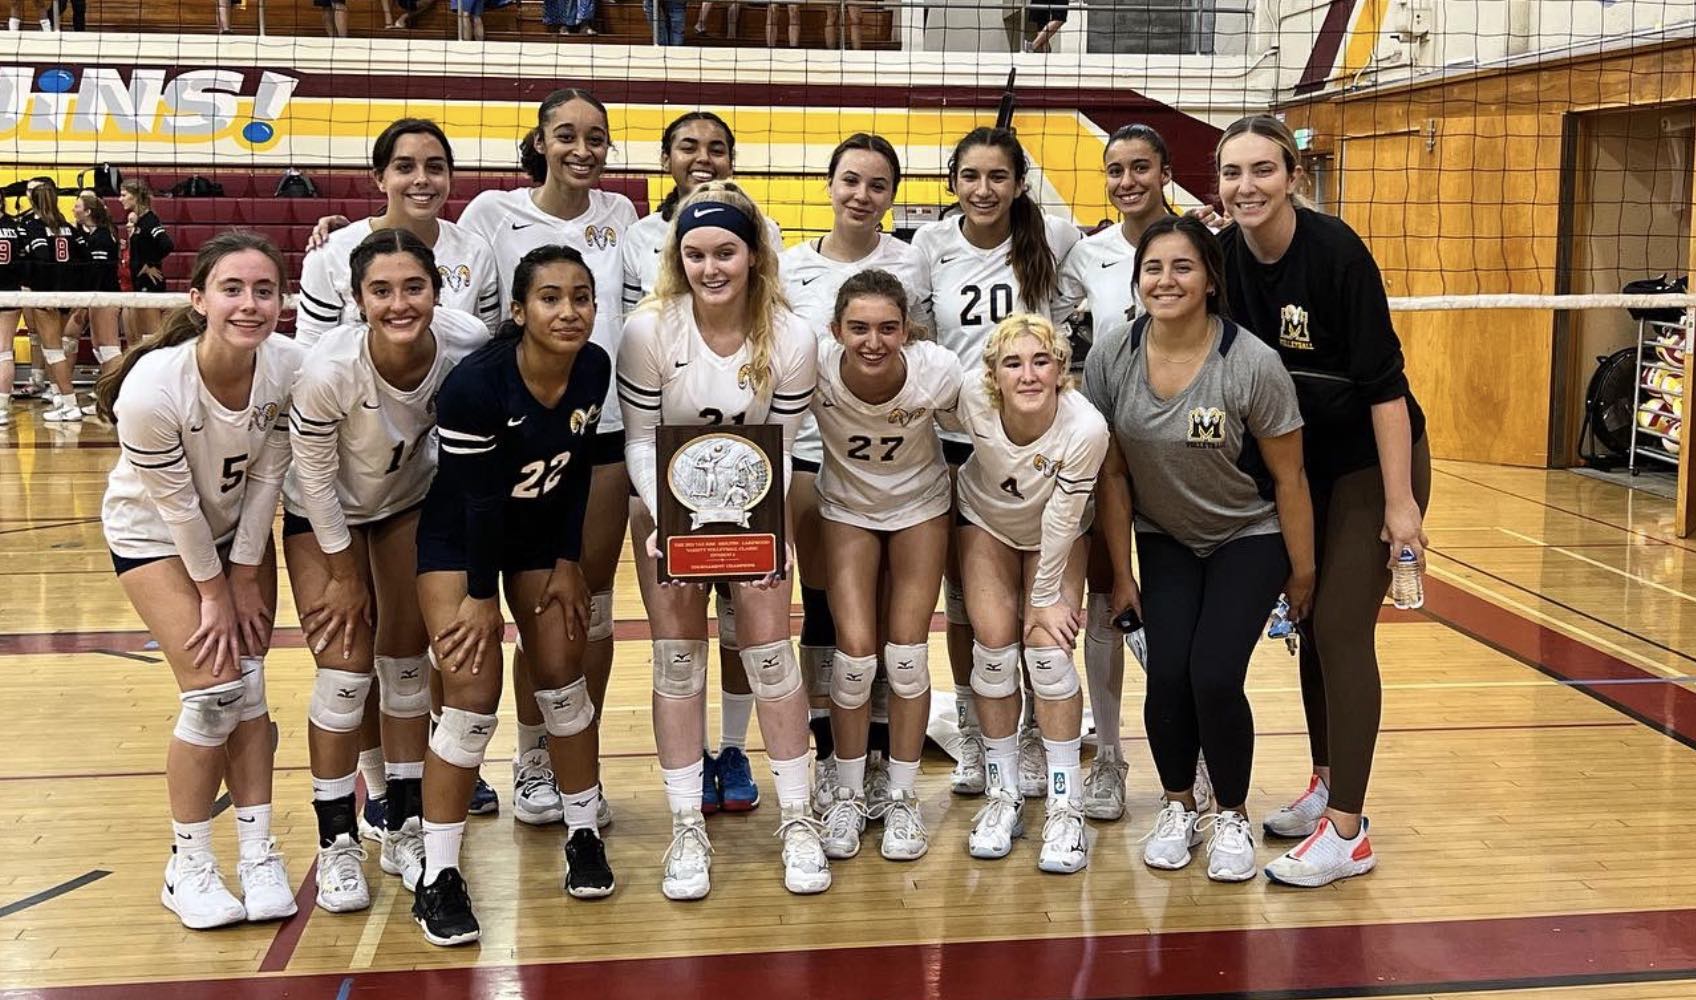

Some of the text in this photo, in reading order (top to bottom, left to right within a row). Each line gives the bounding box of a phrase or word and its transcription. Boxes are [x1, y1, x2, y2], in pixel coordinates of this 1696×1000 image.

[55, 237, 69, 262] 8
[960, 284, 1013, 326] 20
[847, 435, 904, 461] 27
[220, 453, 248, 494] 5
[511, 450, 571, 498] 22
[1000, 477, 1024, 500] 4
